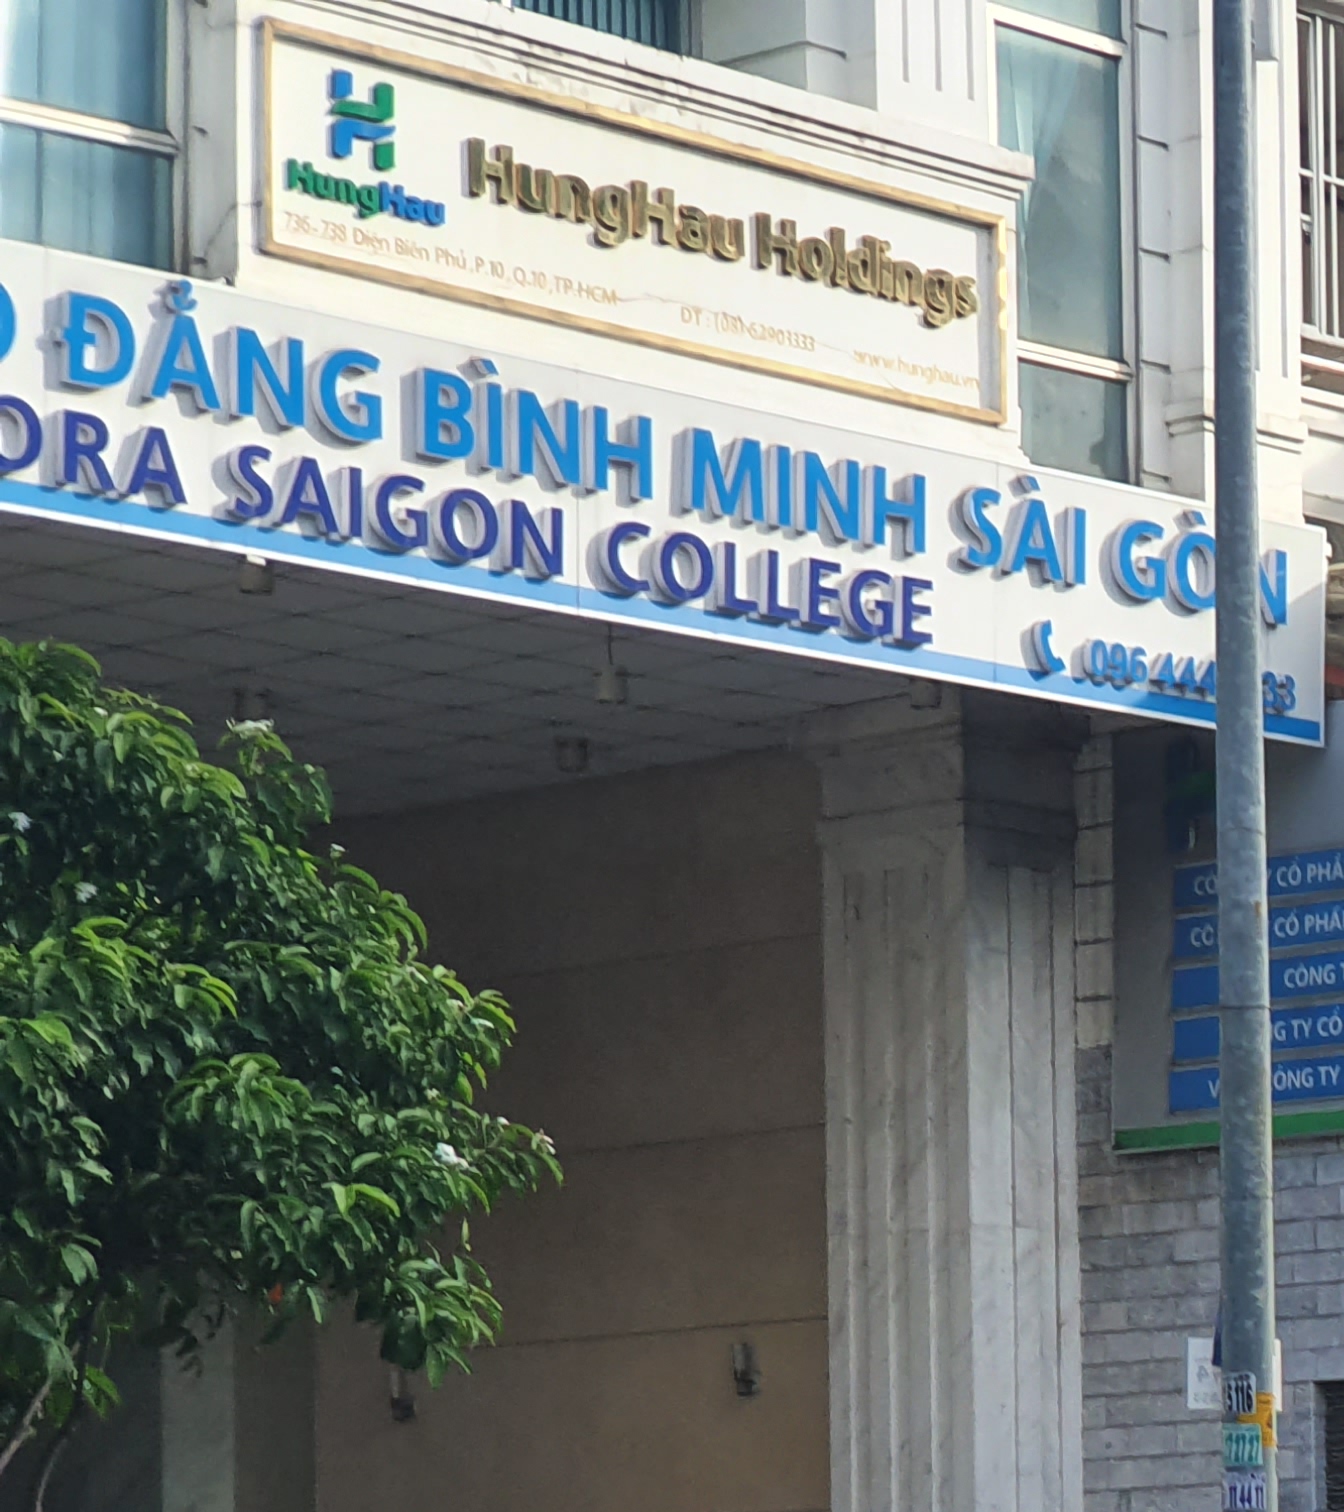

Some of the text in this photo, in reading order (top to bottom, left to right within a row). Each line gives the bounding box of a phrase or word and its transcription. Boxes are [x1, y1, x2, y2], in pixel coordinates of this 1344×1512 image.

[286, 158, 445, 227] HungHau
[463, 137, 979, 328] HungHau Holdings
[422, 356, 653, 501] BÌNH
[690, 424, 926, 555] MINH
[964, 474, 1086, 585] SÀI
[1118, 508, 1288, 626] GÒN
[234, 445, 563, 578] SAIGON
[606, 523, 933, 645] COLLEGE
[1090, 638, 1148, 684] 096
[1284, 960, 1336, 989] CÔNG
[1291, 1017, 1312, 1041] TY
[1273, 1063, 1314, 1092] ÔNG
[1318, 1064, 1341, 1086] TY
